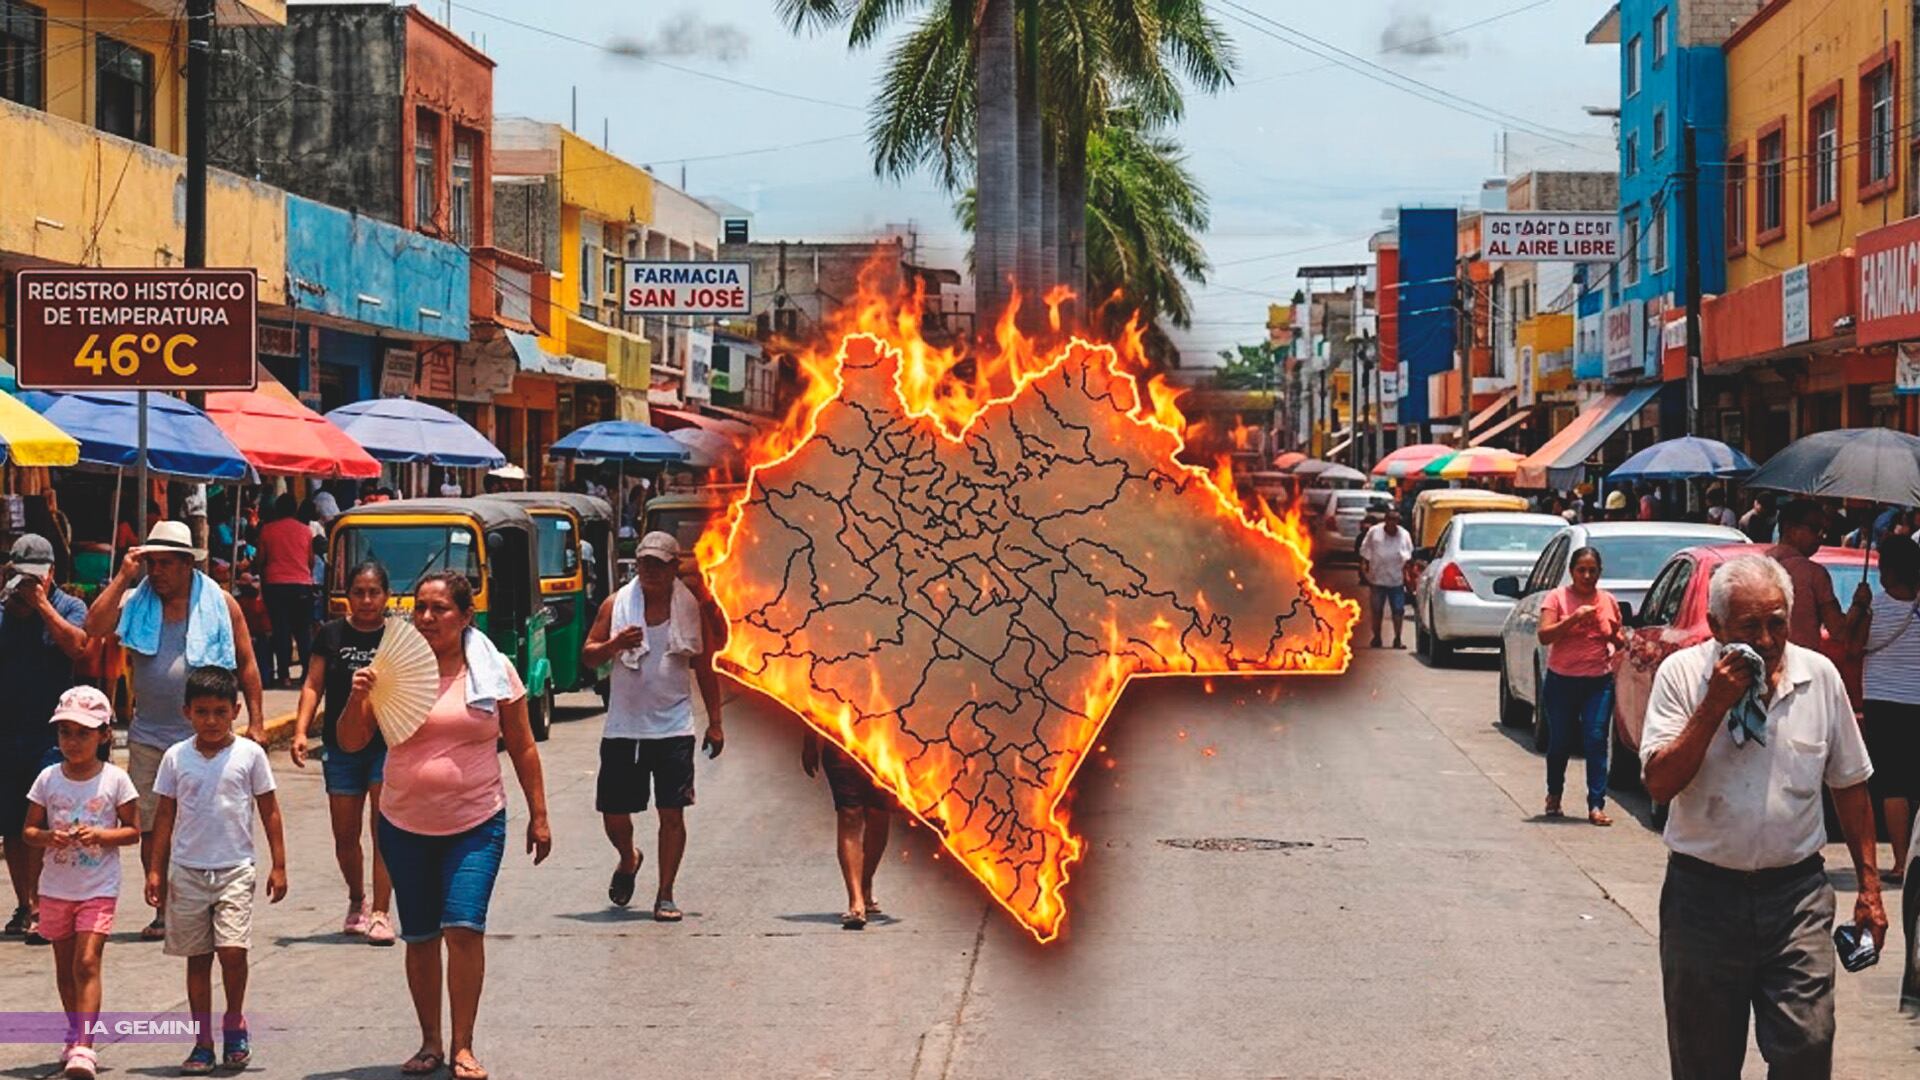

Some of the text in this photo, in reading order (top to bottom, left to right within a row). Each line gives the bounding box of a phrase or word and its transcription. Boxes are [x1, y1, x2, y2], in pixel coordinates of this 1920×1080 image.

[1488, 241, 1616, 255] AL AIRE LIBRE
[634, 268, 740, 284] FARMACIA
[28, 278, 245, 300] REGISTRO HISTÓRICO
[629, 286, 744, 308] SAN JOSÉ
[44, 307, 229, 325] DE TEMPERATURA
